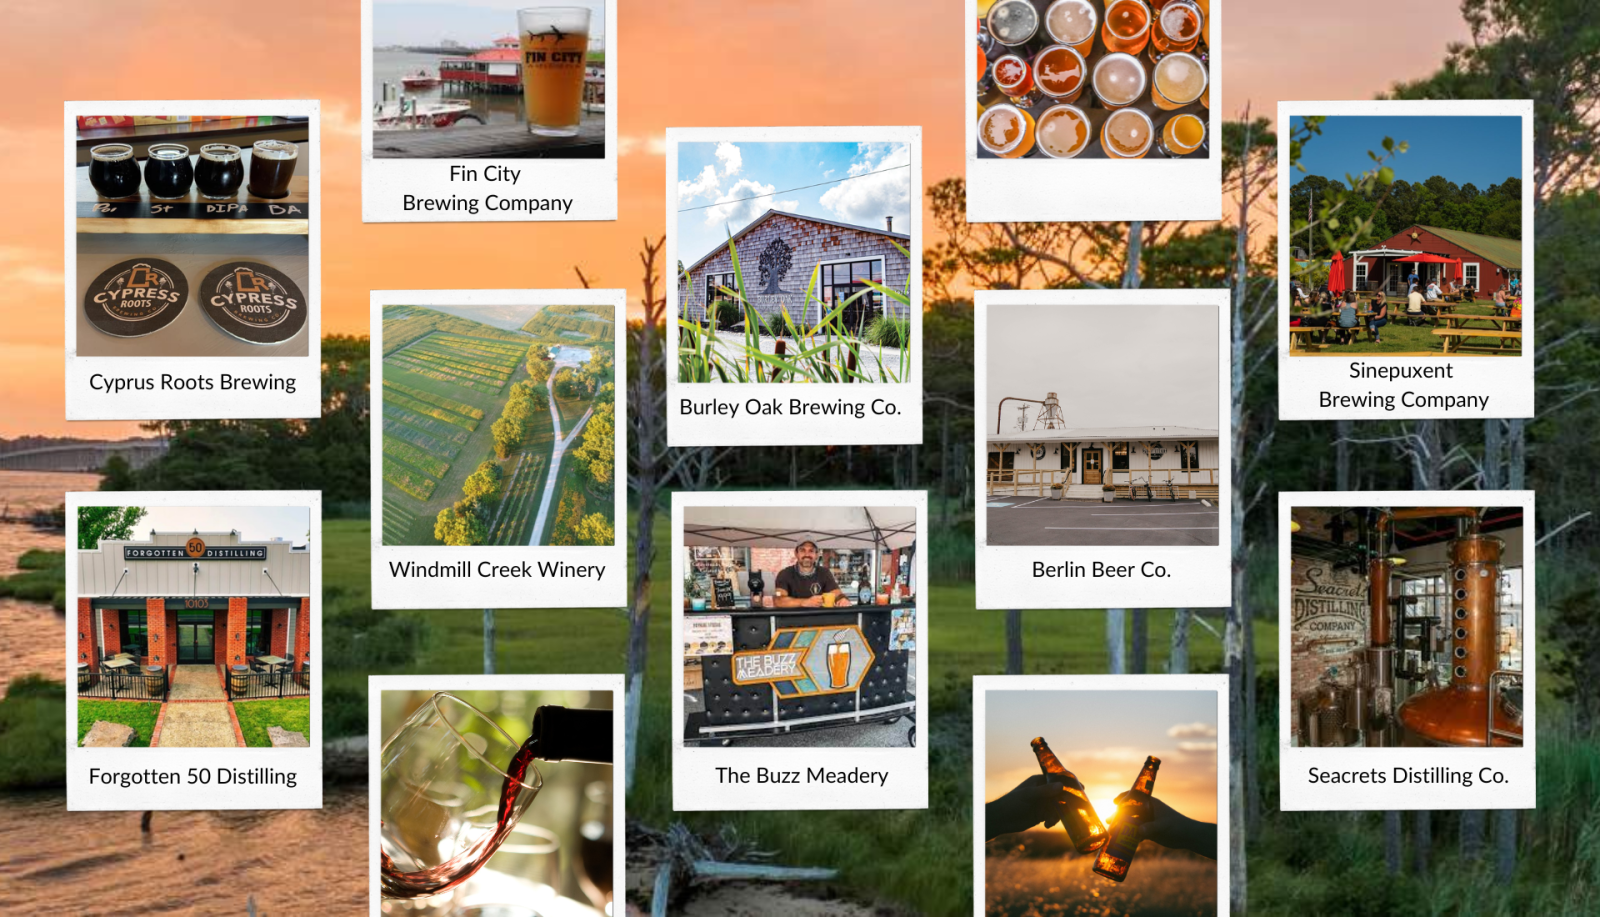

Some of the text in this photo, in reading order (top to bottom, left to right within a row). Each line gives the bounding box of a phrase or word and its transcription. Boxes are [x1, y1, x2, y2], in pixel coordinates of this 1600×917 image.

[525, 51, 583, 63] FIN CITY
[206, 203, 249, 213] DIPA
[268, 204, 302, 215] BA
[93, 287, 181, 304] CYPRESS
[210, 292, 298, 310] CYPRESS
[120, 299, 152, 308] ROOTS
[240, 304, 272, 314] ROOTS
[112, 305, 144, 317] BREWING
[233, 310, 269, 323] BREWING
[127, 542, 263, 557] FORGOTTEN 50 DISTILLING
[1295, 599, 1367, 622] DISTILLING
[1309, 621, 1356, 632] COMPANY
[736, 652, 797, 668] THE BUZZ
[736, 663, 796, 680] MEADERY
